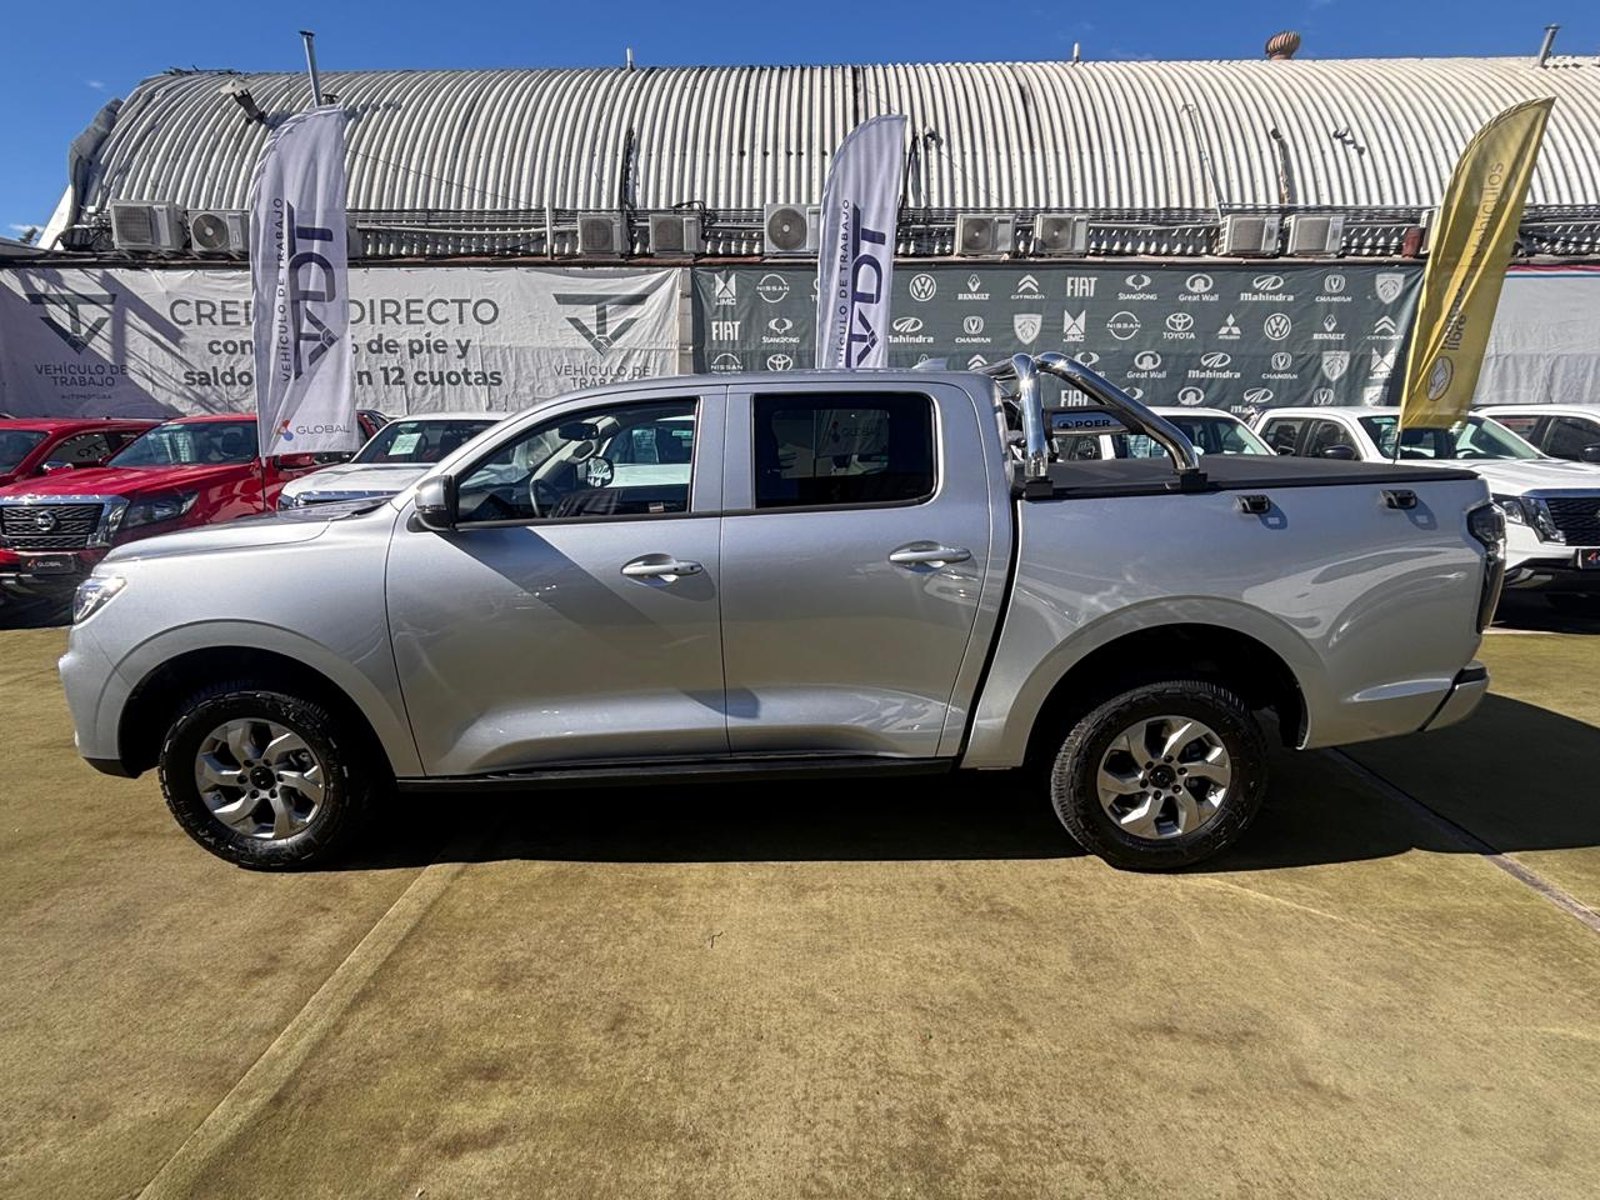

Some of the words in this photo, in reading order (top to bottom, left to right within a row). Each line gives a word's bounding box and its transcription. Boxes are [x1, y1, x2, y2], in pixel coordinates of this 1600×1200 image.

[273, 198, 284, 270] TRABAJO
[839, 199, 849, 273] TRABAJO
[278, 278, 285, 297] DE
[839, 279, 847, 298] DE
[1066, 277, 1098, 298] FIAT
[1178, 293, 1199, 302] Great
[1201, 293, 1219, 302] Wall
[1240, 292, 1295, 302] Mahindra
[711, 321, 741, 341] FIAT
[1163, 332, 1196, 340] TOYOTA
[1313, 333, 1346, 341] RENAULT
[1446, 313, 1467, 351] libre
[208, 339, 253, 355] con
[366, 333, 400, 355] de
[456, 339, 472, 359] y
[277, 304, 291, 382] VEHÍCULO
[1063, 335, 1085, 343] JMC
[34, 361, 105, 375] VEHÍCULO
[109, 364, 127, 375] DE
[554, 361, 627, 377] VEHÍCULO
[632, 365, 651, 377] DE
[1127, 370, 1148, 379] Great
[1150, 370, 1167, 379] Wall
[1188, 369, 1241, 378] Mahindra
[51, 376, 115, 387] TRABAJO
[184, 366, 253, 387] saldo
[380, 366, 406, 386] 12
[414, 367, 503, 387] cuotas
[296, 424, 351, 436] GLOBAL
[1075, 418, 1111, 429] POER
